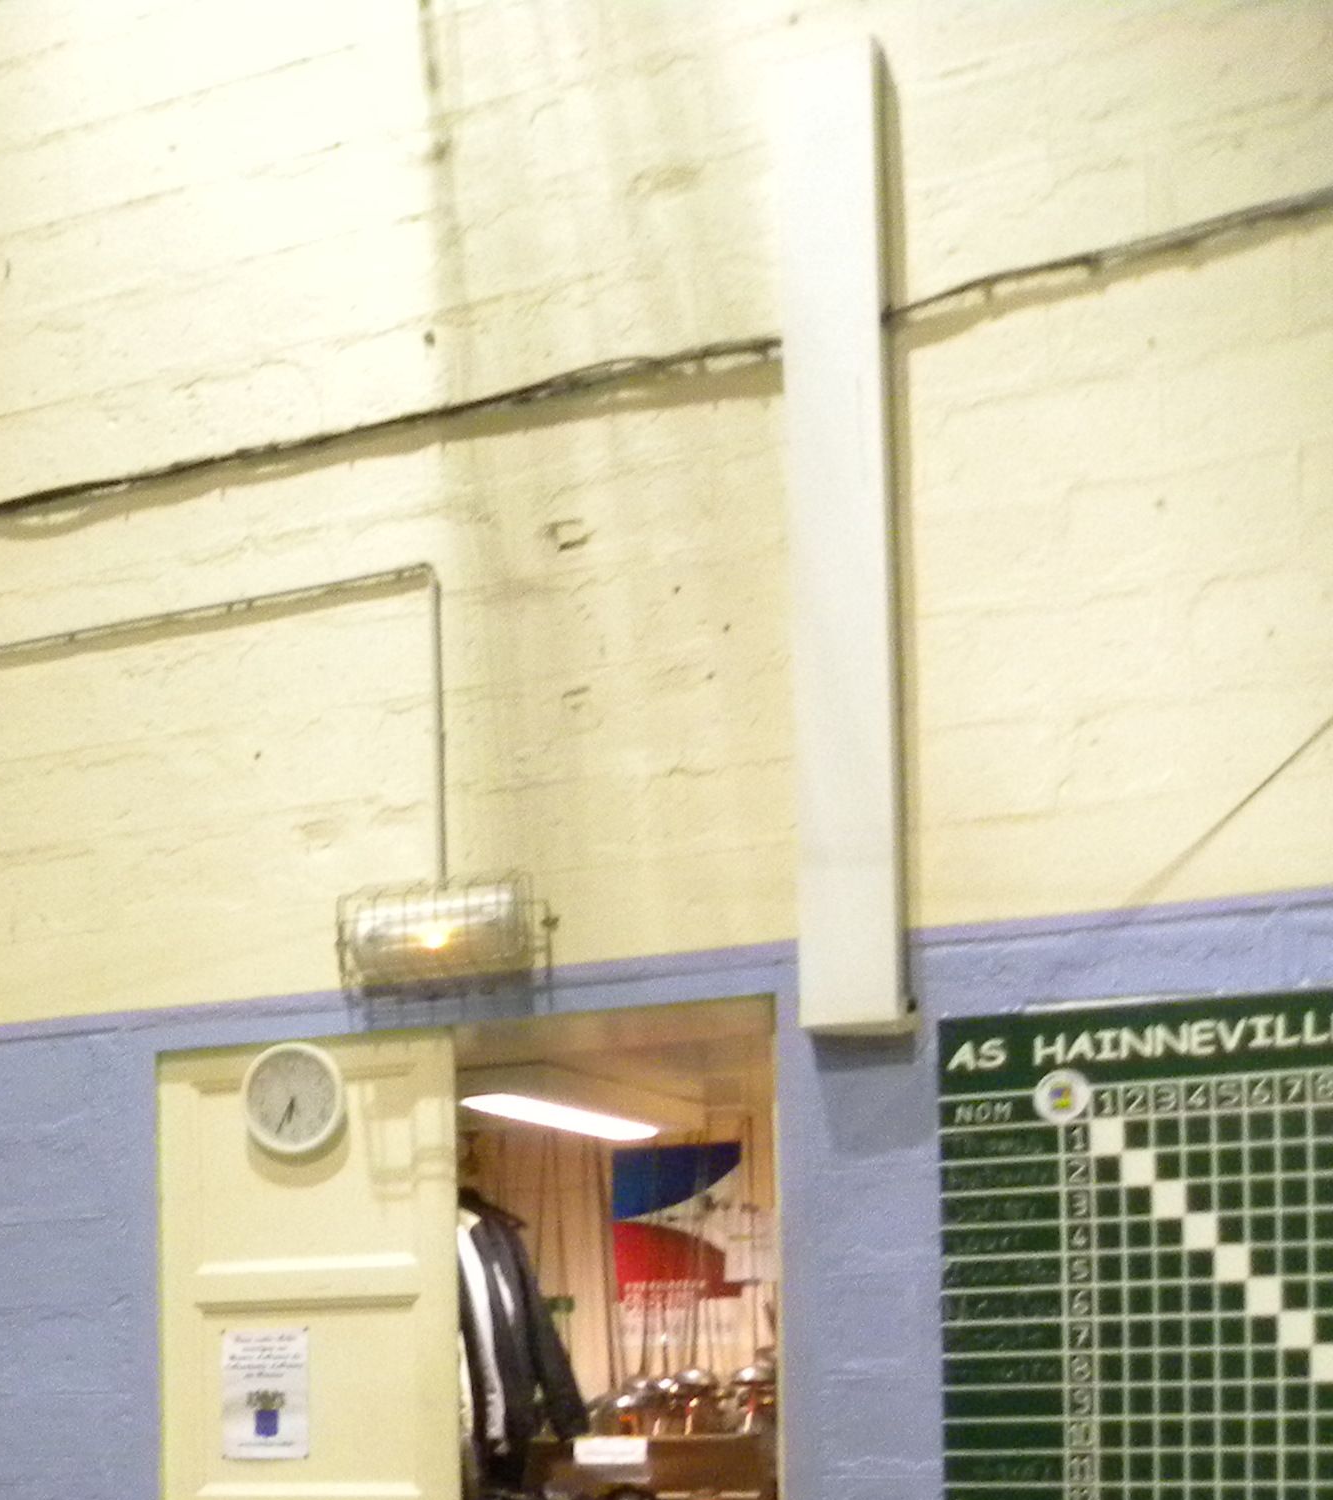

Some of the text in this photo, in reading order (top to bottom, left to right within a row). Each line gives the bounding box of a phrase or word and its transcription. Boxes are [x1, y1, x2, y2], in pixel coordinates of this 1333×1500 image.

[947, 1010, 1333, 1071] AS HAINNEVILL
[954, 1101, 1013, 1124] NOM
[1071, 1126, 1085, 1149] 1
[1069, 1160, 1087, 1184] 2
[1072, 1193, 1088, 1216] 3
[1072, 1226, 1088, 1247] 4
[1072, 1323, 1090, 1347] 7
